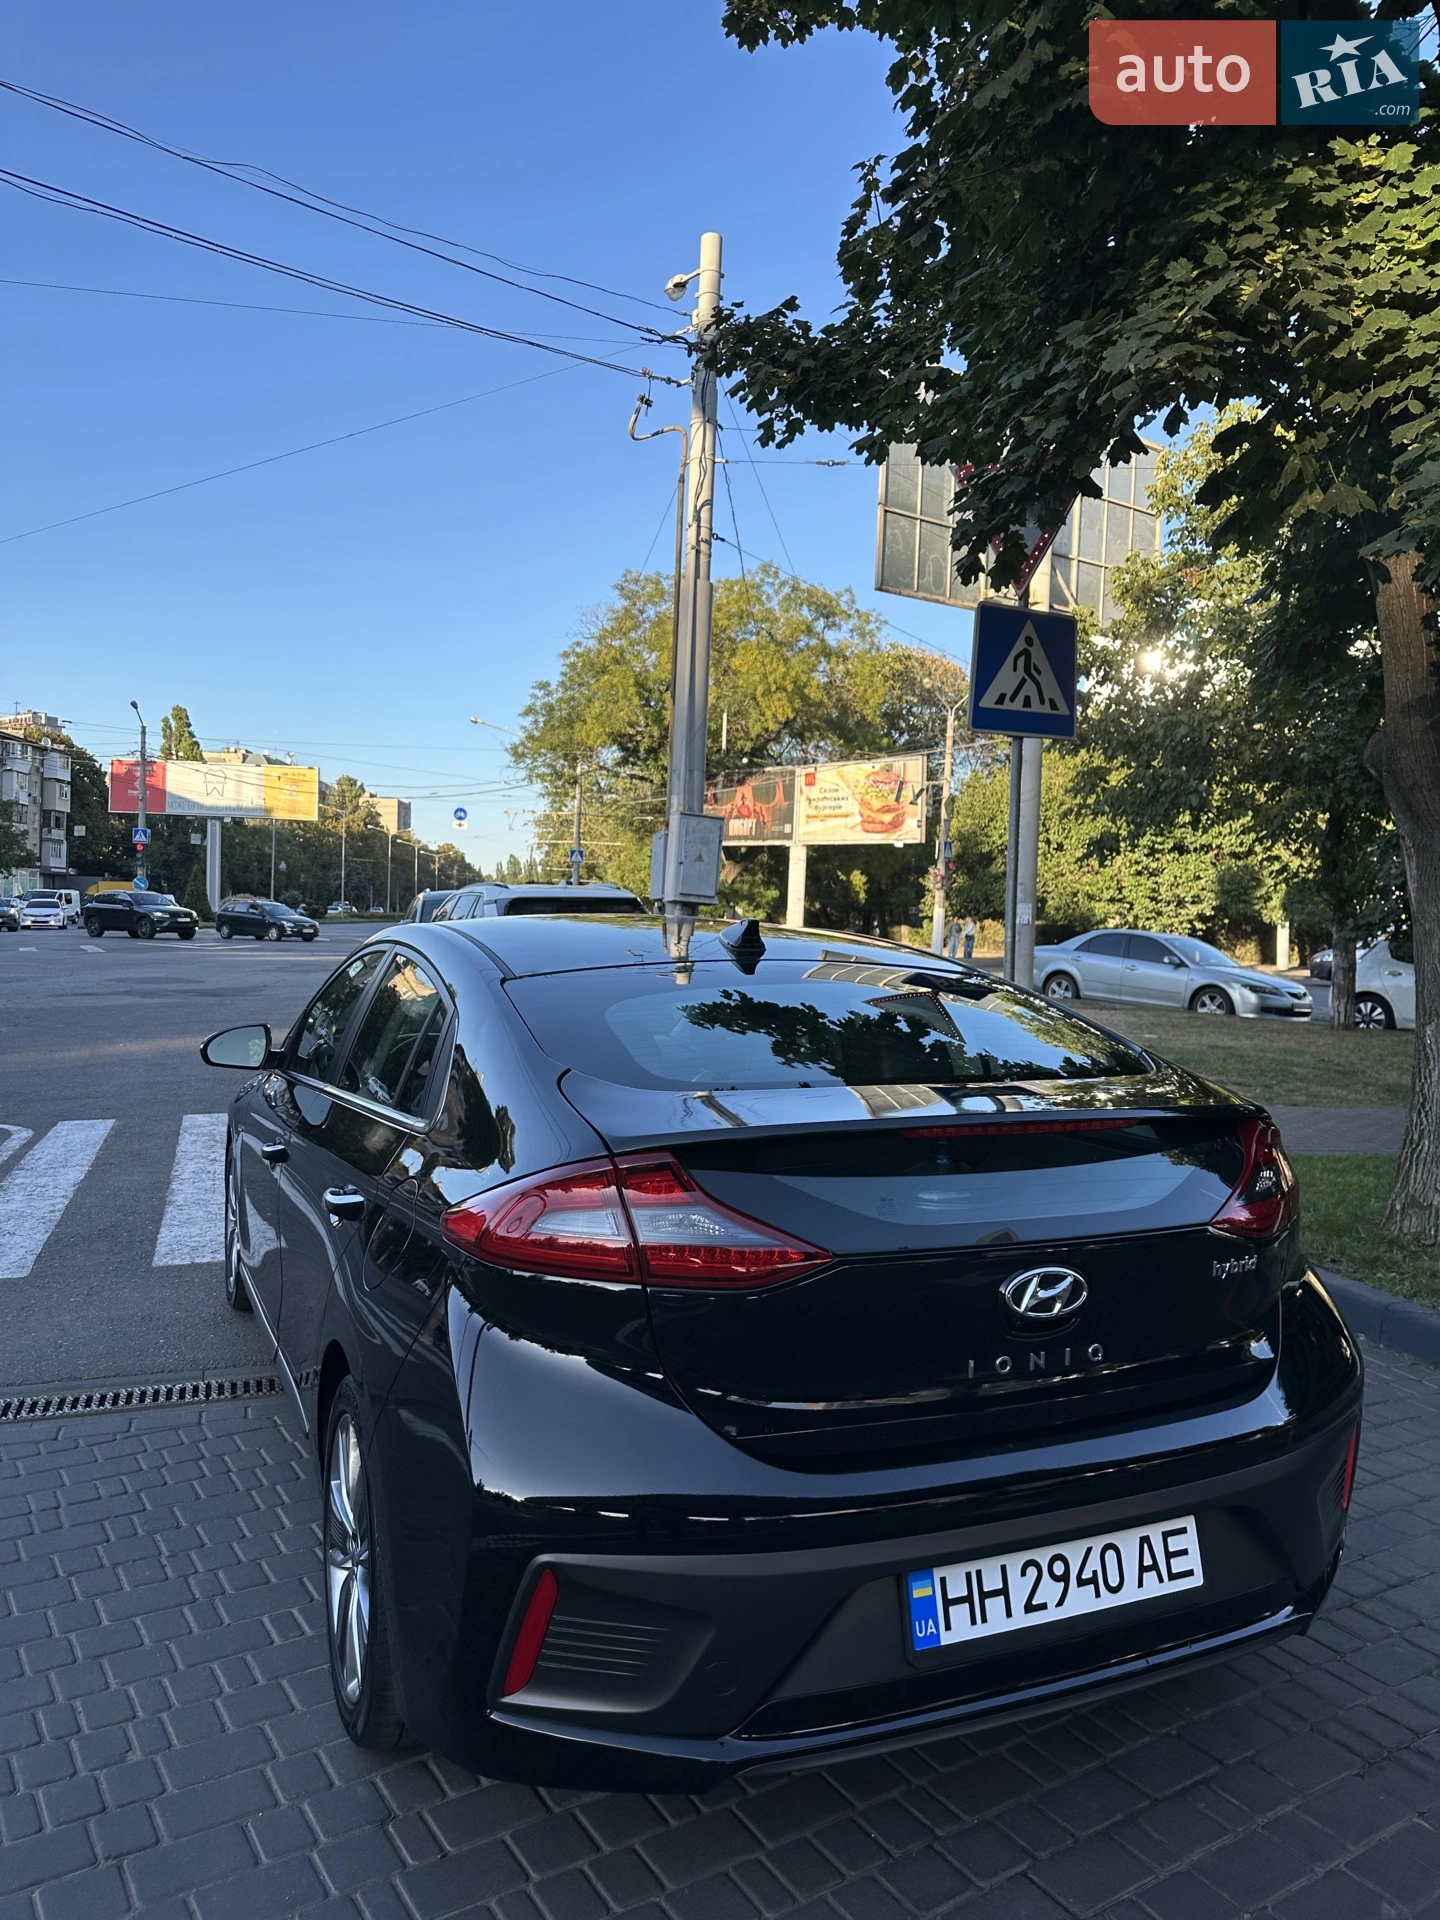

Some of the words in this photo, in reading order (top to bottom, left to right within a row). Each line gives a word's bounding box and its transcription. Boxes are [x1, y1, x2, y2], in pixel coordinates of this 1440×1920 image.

[1212, 1254, 1258, 1279] hybrid
[968, 1343, 1104, 1378] IONIQ
[1020, 1542, 1125, 1615] 2940
[915, 1619, 937, 1638] UA
